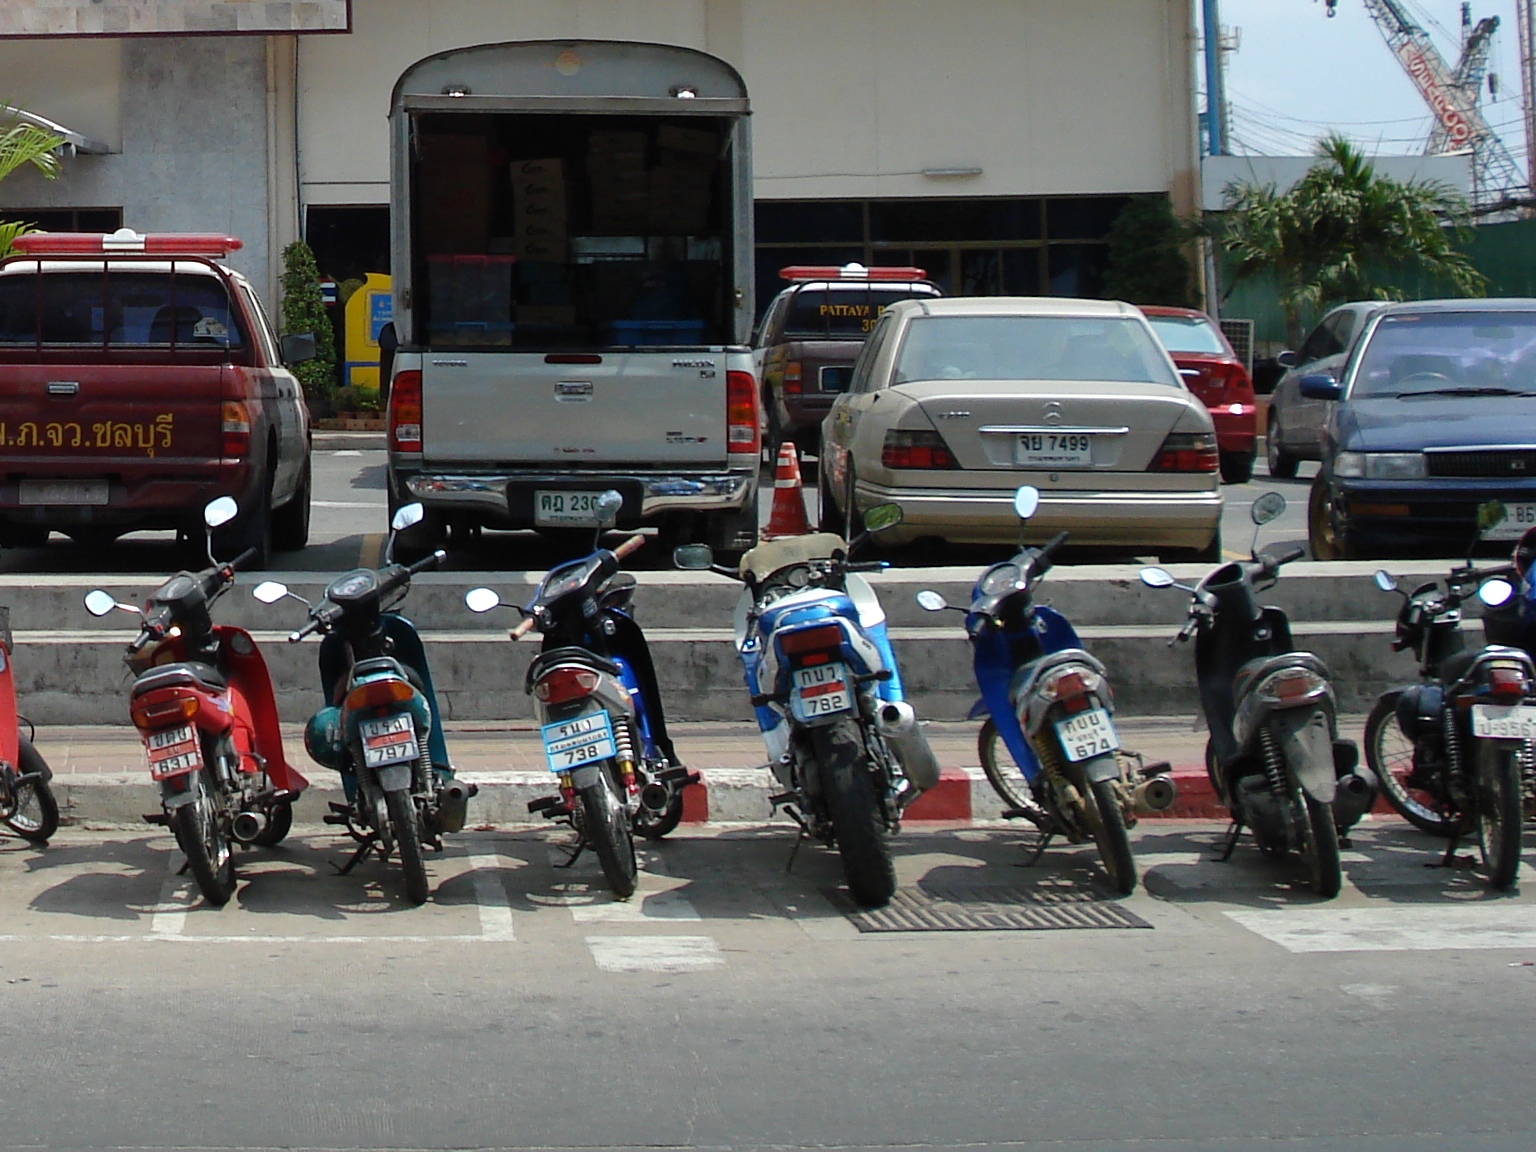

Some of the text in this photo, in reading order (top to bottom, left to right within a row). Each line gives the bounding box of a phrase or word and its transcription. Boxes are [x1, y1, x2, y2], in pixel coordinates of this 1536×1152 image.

[819, 305, 870, 317] PATTAYA
[1049, 436, 1090, 451] 7499
[808, 695, 844, 715] 782
[374, 744, 407, 762] 797
[564, 745, 599, 765] 738
[1075, 739, 1111, 759] 674
[159, 753, 190, 774] 631
